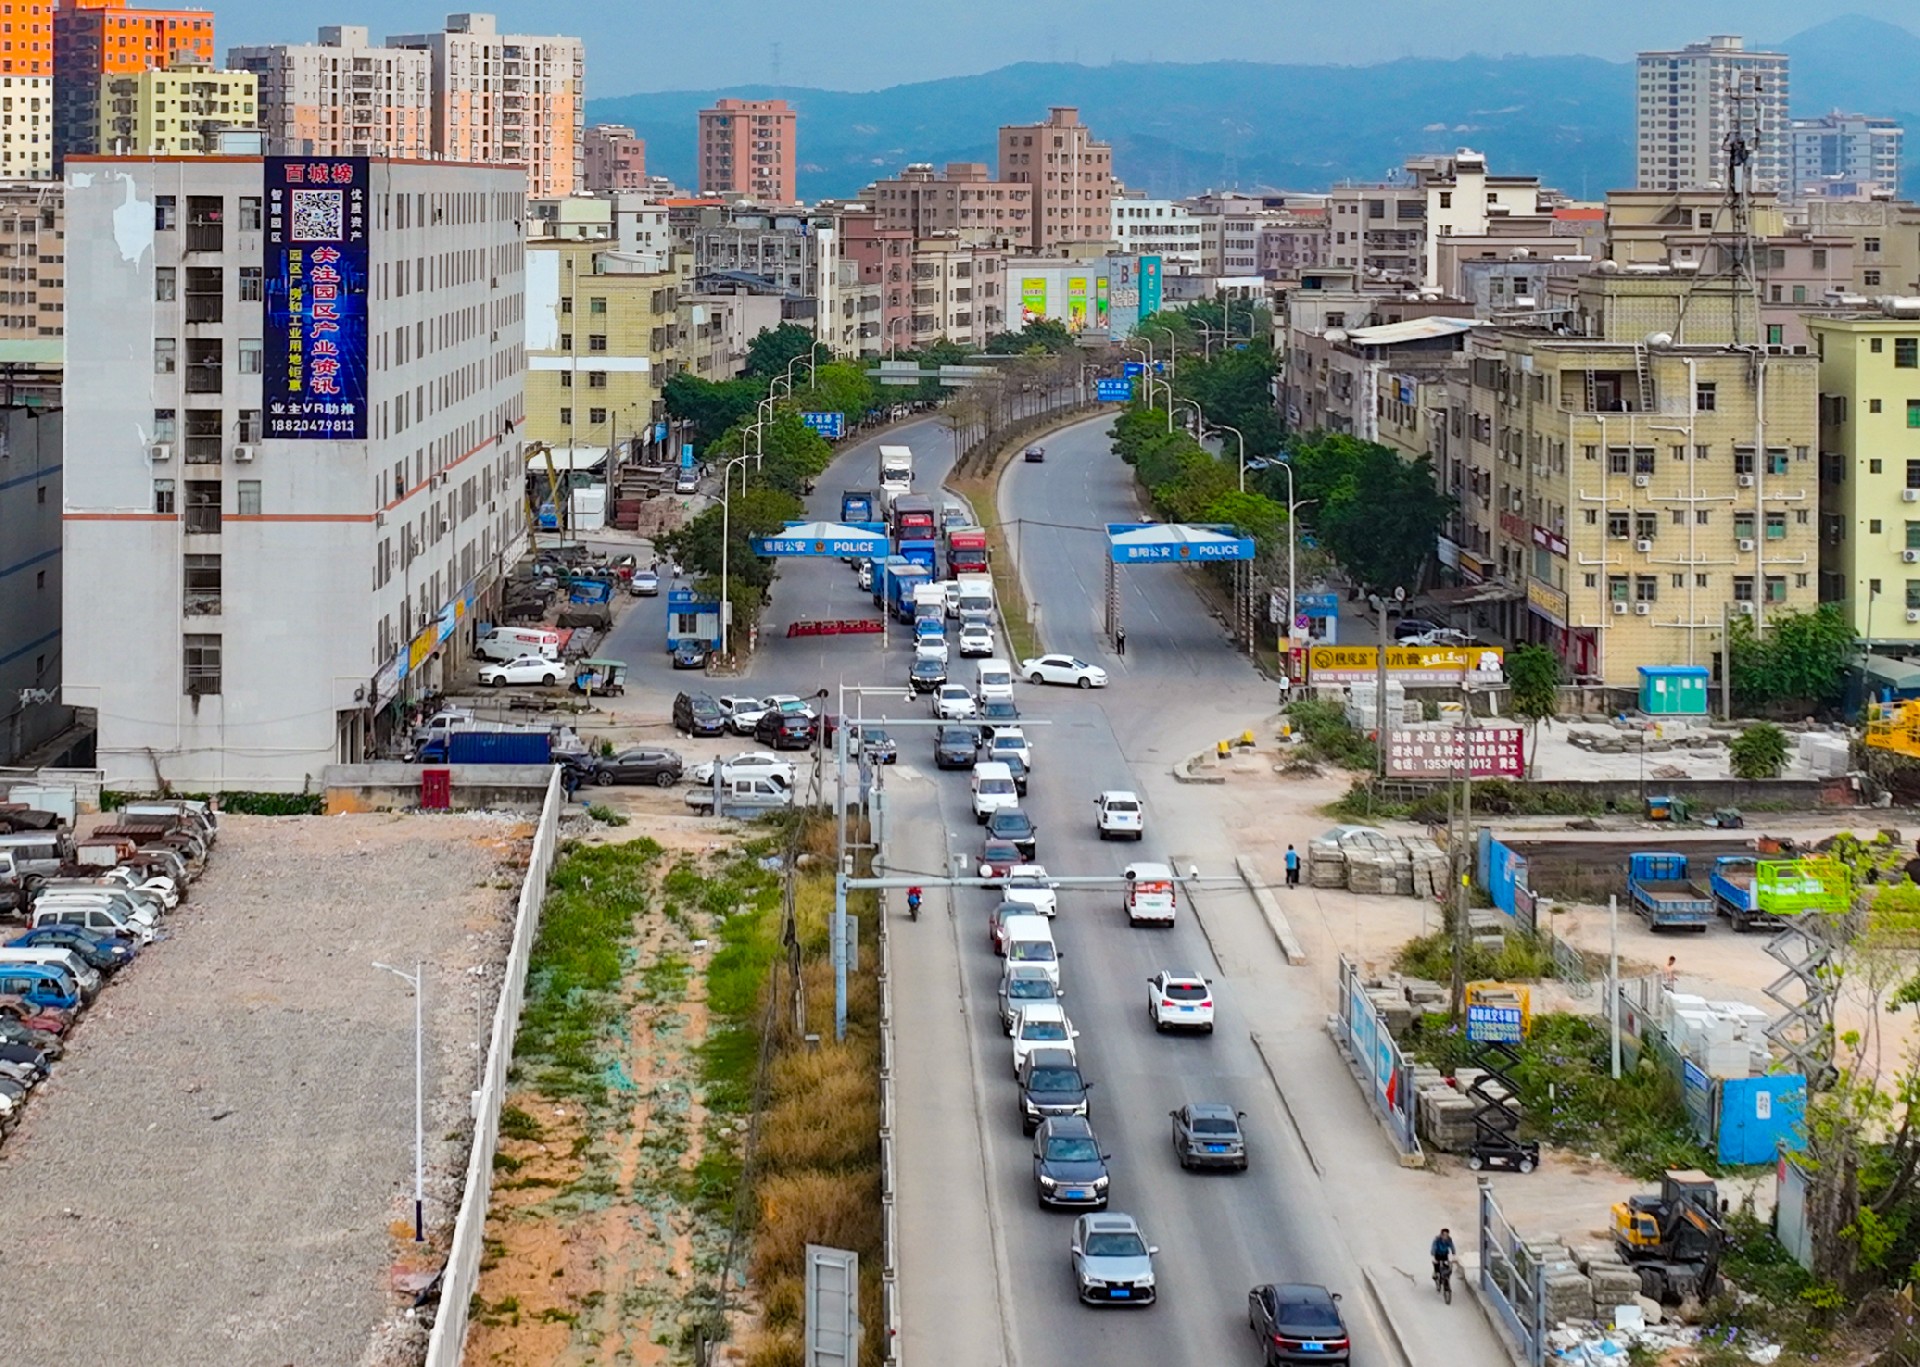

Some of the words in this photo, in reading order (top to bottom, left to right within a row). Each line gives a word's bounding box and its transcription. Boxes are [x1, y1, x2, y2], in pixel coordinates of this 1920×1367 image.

[284, 163, 353, 184] 百城榜
[310, 246, 341, 394] 关注园区产业资讯
[833, 541, 873, 552] POLICE
[1199, 545, 1239, 555] POLICE
